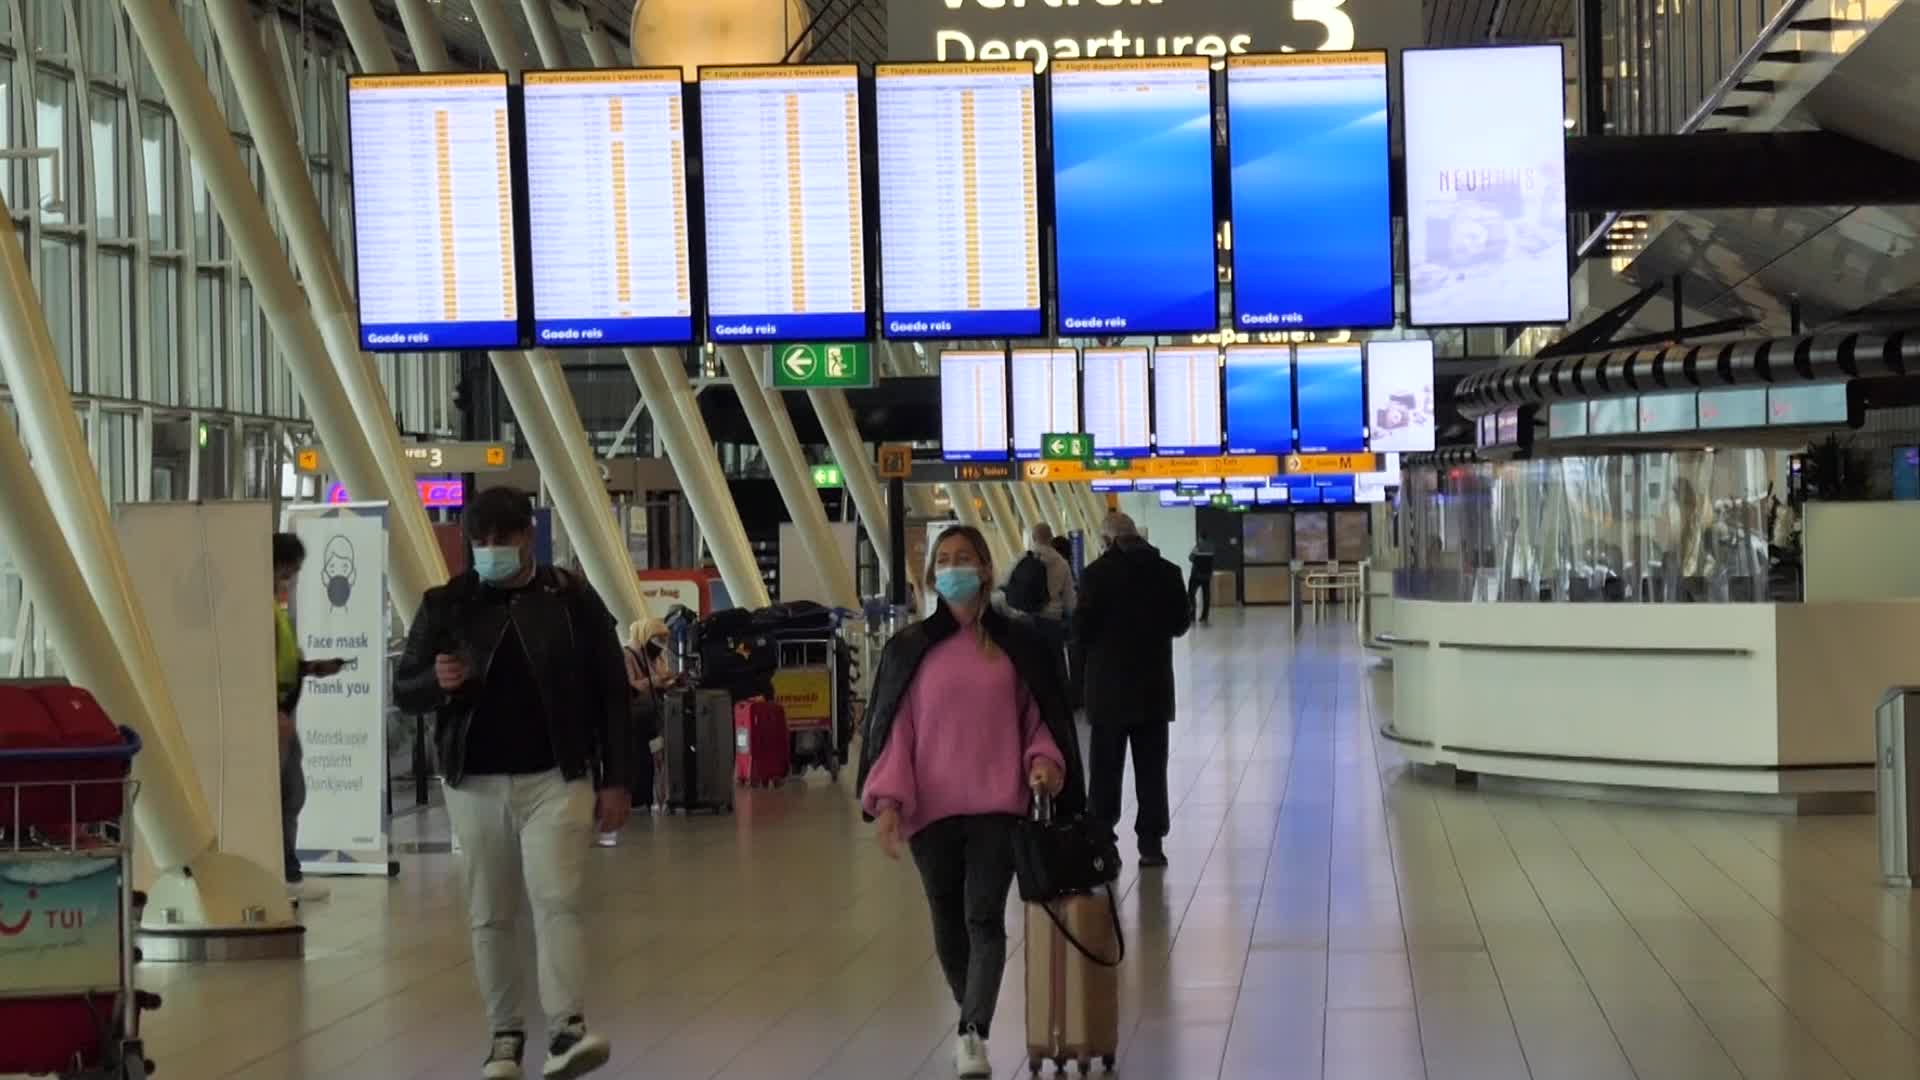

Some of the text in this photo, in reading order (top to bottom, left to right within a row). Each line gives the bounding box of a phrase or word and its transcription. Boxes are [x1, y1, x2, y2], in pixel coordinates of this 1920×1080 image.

[1065, 316, 1127, 328] Goede reis
[1241, 312, 1303, 324] Goede reis
[716, 323, 777, 335] Goede reis
[890, 320, 952, 332] Goede reis
[367, 332, 429, 344] Goede reis
[541, 328, 603, 340] Goede reis
[429, 448, 442, 468] 3
[307, 631, 369, 648] Face mask
[306, 680, 369, 697] Thank you
[44, 908, 83, 929] TUI
